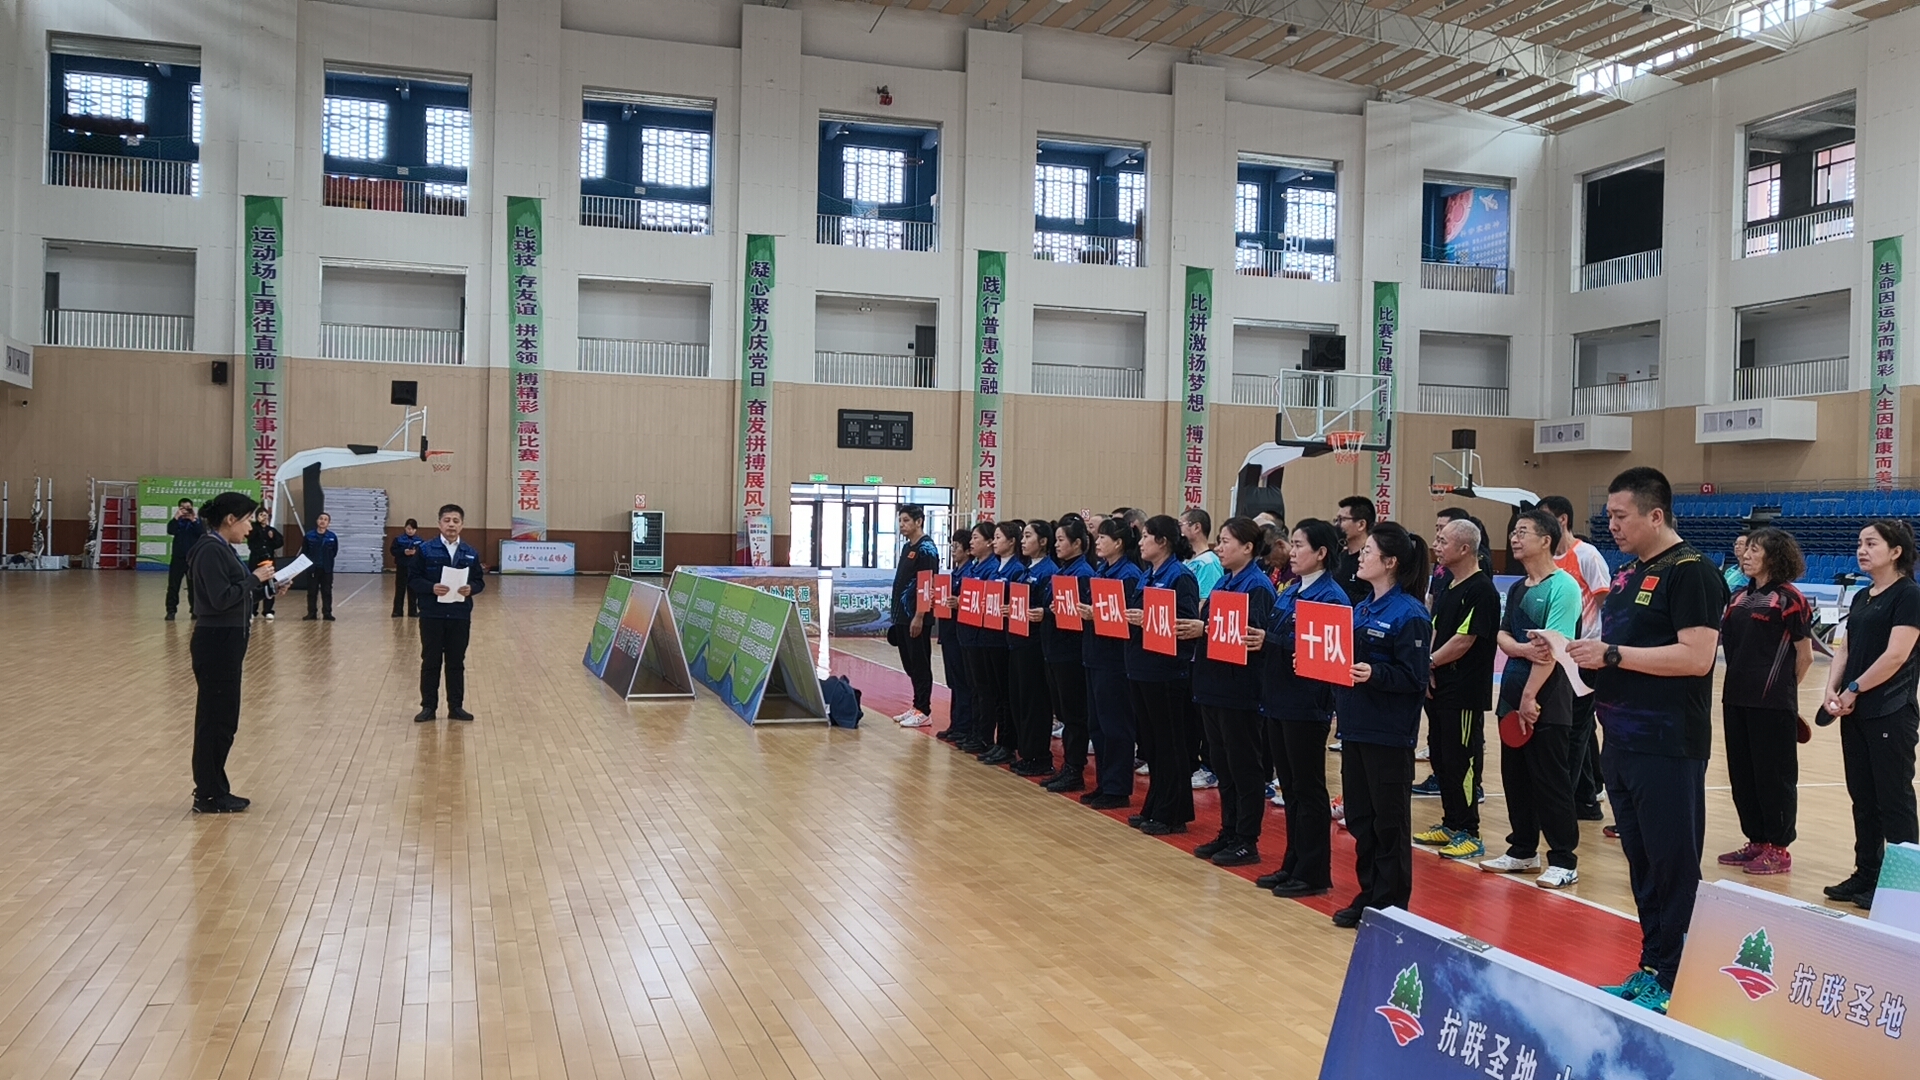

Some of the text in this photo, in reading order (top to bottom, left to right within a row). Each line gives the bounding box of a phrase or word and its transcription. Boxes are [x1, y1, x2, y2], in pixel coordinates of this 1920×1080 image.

[747, 261, 771, 388] 凝心聚力庆党日
[1877, 262, 1895, 377] 生命因运动而精彩
[251, 226, 278, 512] 运动场上勇往直前 工作事业无往不
[513, 226, 541, 511] 比球技 存友谊 拼本领 搏精彩 赢比赛 享喜悦
[1186, 293, 1208, 413] 比拼激扬梦想
[976, 276, 1001, 523] 践行普惠金融 厚植为民情怀
[1375, 432, 1391, 523] 动与友谊
[1702, 484, 1712, 493] C1
[757, 585, 811, 602] 外桃源
[917, 580, 930, 602] 一队
[935, 585, 948, 607] 二队
[961, 590, 980, 614] 三队
[985, 593, 1001, 617] 四队
[1010, 596, 1027, 622] 五队
[1055, 589, 1078, 616] 六队
[1095, 593, 1124, 623] 七队
[800, 608, 811, 623] 园
[1145, 604, 1172, 638] 八队
[1211, 607, 1244, 646] 九队
[1300, 621, 1347, 666] 十队
[1788, 963, 1907, 1039] 抗联圣地
[1437, 1008, 1538, 1080] 抗联圣地
